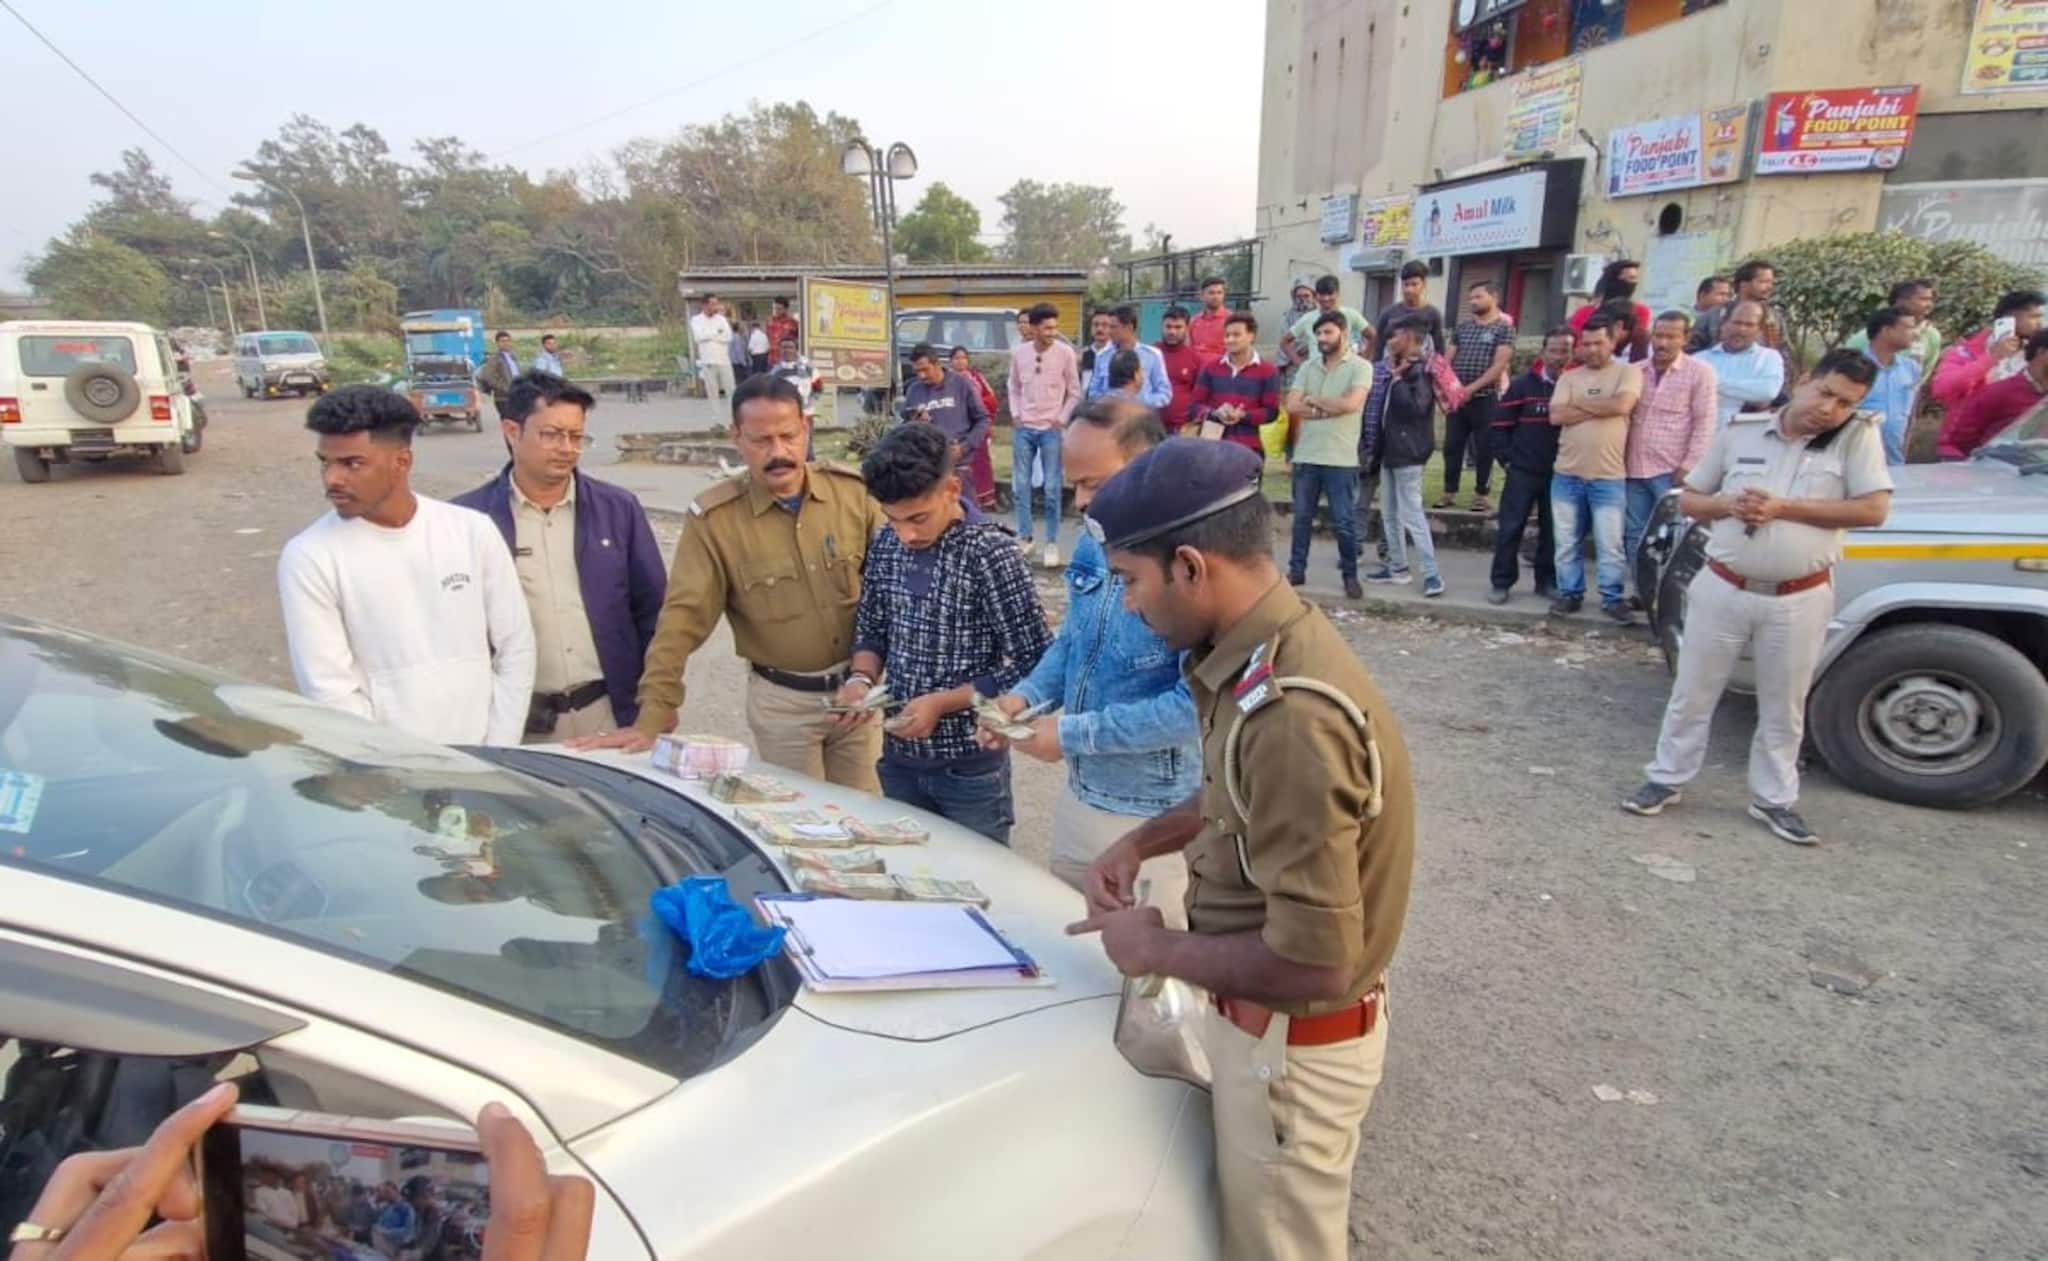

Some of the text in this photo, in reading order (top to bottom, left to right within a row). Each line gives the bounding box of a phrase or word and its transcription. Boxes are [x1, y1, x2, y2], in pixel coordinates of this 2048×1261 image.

[1807, 97, 1904, 122] Punjabi
[1803, 115, 1911, 133] FOOD POINT
[1628, 128, 1691, 157] Punjabi
[1625, 150, 1698, 174] FOOD POINT
[1453, 195, 1515, 223] Amul Milk
